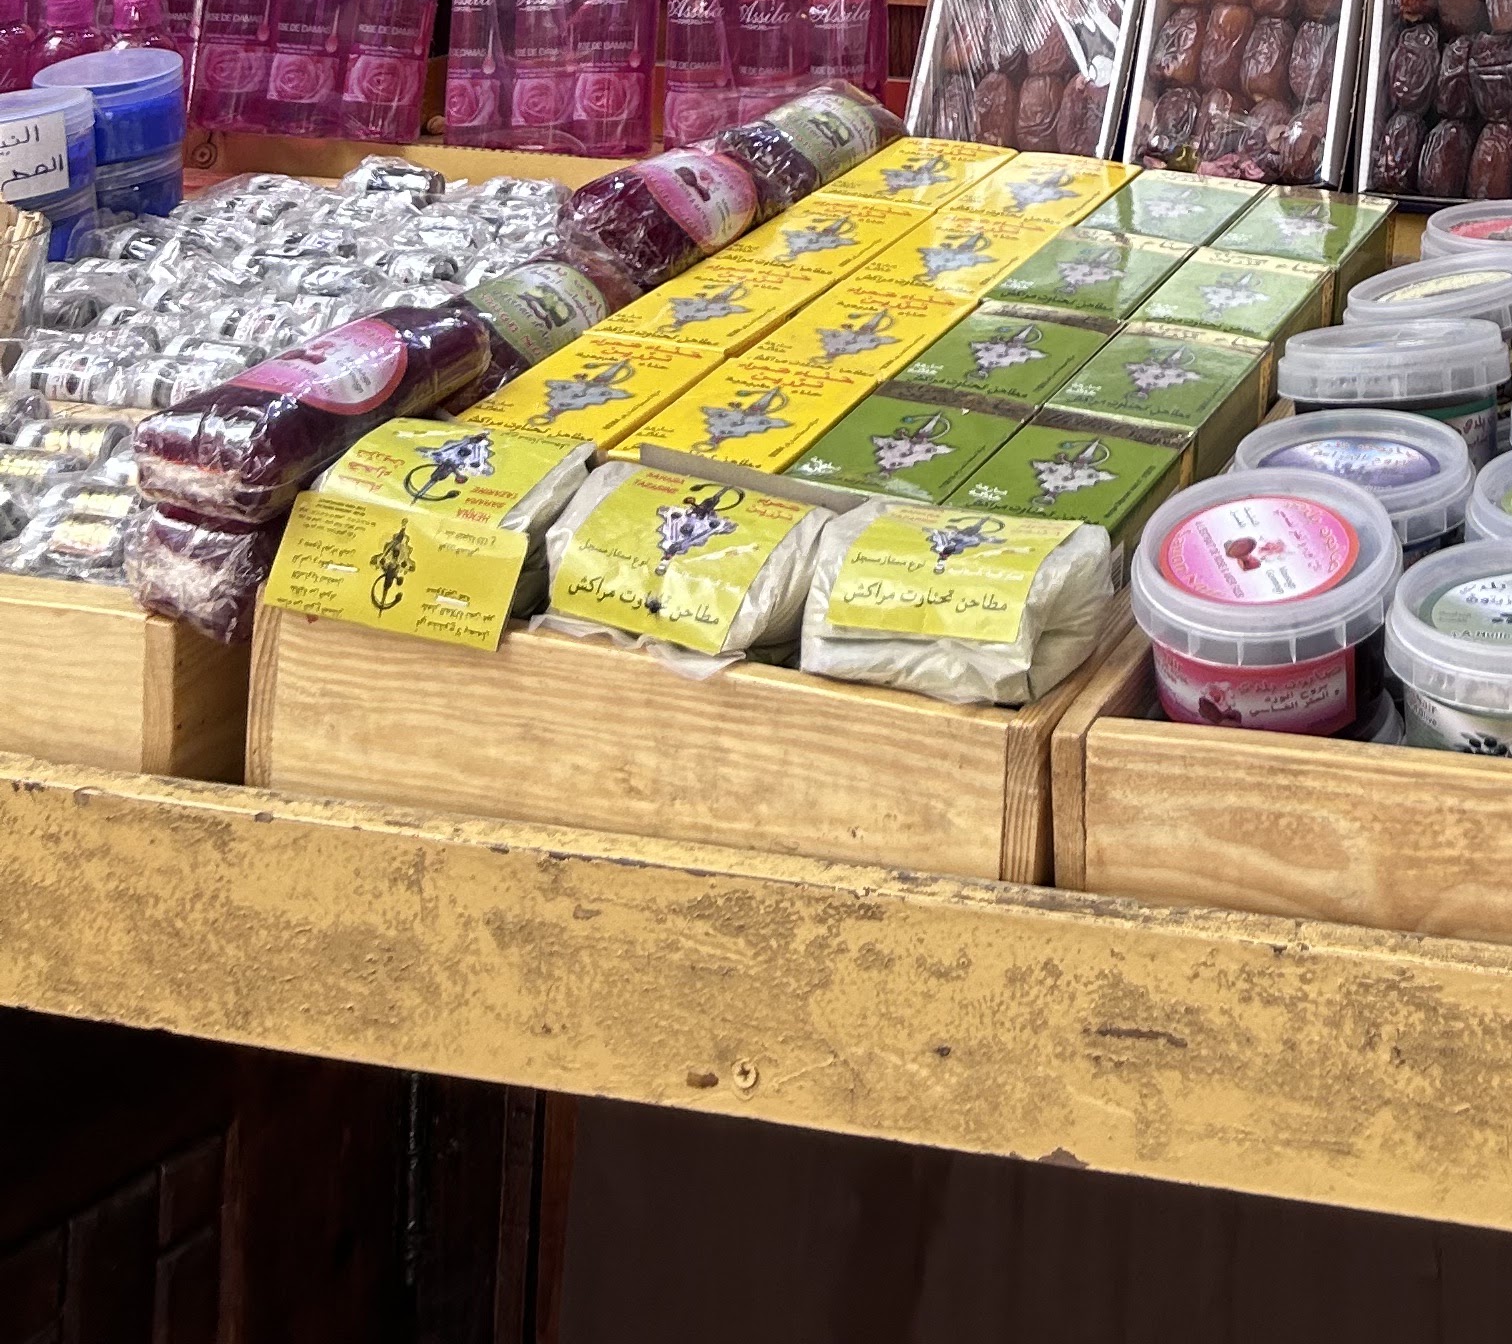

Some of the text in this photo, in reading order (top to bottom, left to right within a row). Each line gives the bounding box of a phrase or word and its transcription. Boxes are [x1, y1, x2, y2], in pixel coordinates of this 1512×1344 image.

[740, 0, 791, 23] Assila
[1, 154, 64, 191] الصحر
[457, 508, 489, 523] HENNA
[568, 576, 615, 603] مراكش
[844, 581, 895, 606] مراكش
[956, 593, 1008, 613] مطاحن
